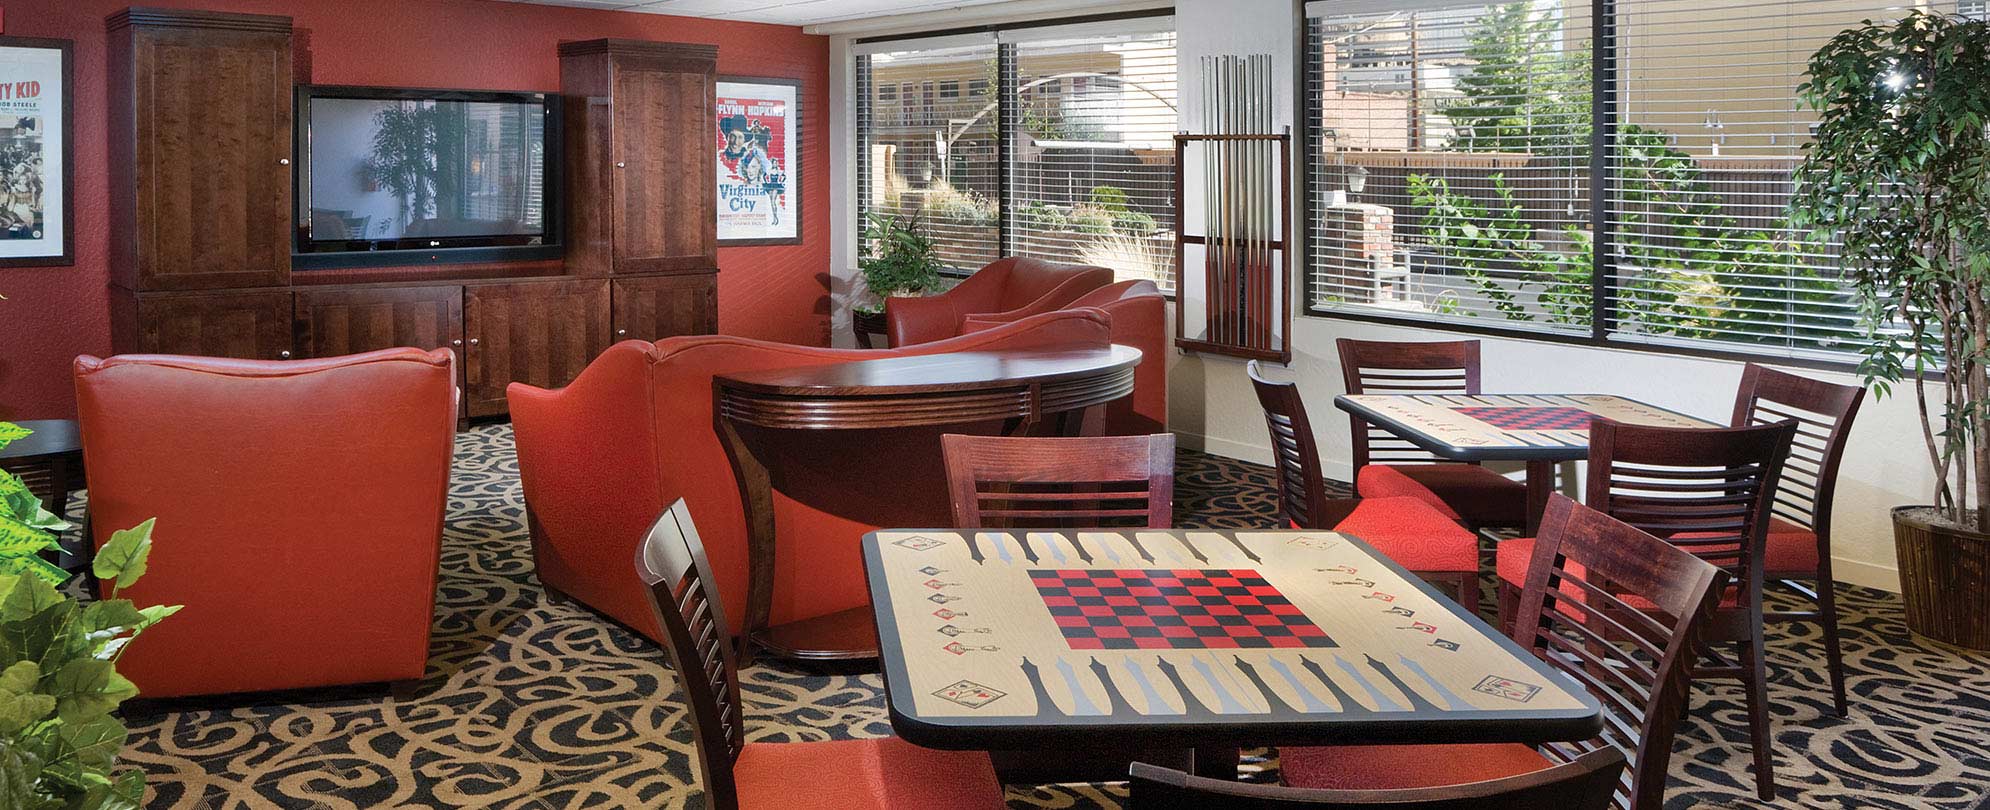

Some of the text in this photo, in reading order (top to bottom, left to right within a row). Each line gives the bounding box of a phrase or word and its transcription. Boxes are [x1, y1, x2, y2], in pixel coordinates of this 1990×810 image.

[16, 80, 41, 98] KID
[719, 184, 766, 199] Virginia
[729, 197, 756, 212] City
